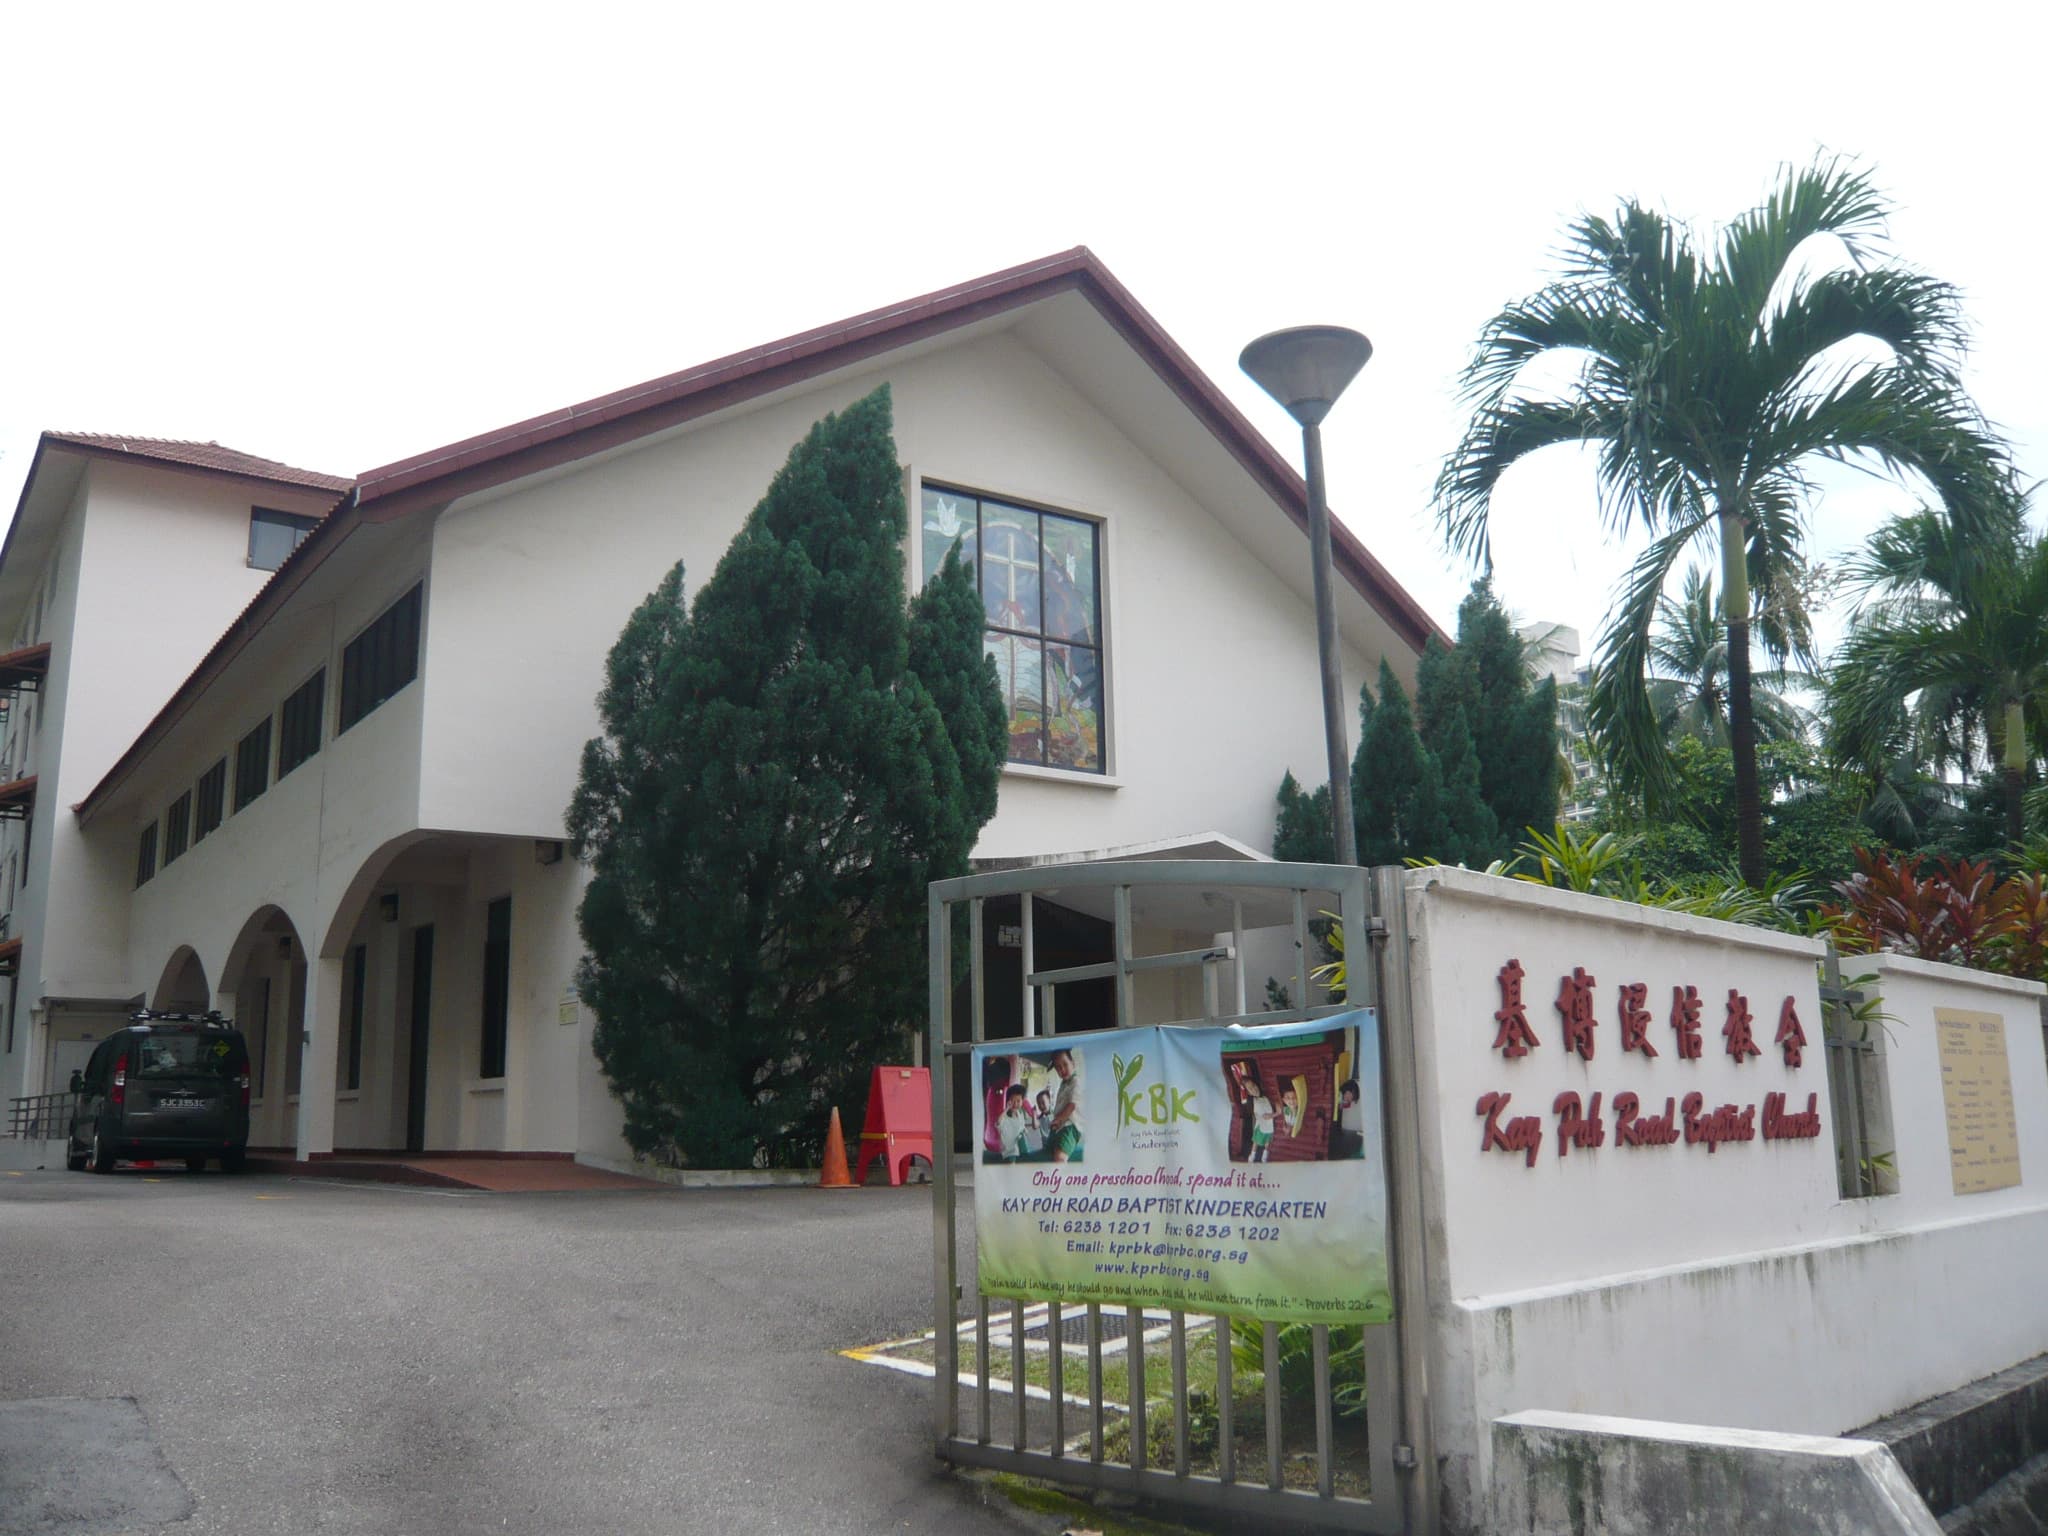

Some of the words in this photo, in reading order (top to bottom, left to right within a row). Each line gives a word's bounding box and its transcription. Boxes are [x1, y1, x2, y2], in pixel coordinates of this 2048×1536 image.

[1122, 1083, 1200, 1126] KBK
[1476, 1091, 1543, 1168] Kay
[1553, 1090, 1605, 1157] Poh
[1613, 1091, 1681, 1147] Road
[1681, 1091, 1757, 1154] Baptist
[1761, 1091, 1822, 1141] Church
[1032, 1168, 1061, 1193] Only
[1066, 1174, 1088, 1186] one
[1186, 1168, 1236, 1194] spend
[1237, 1172, 1247, 1188] it
[1002, 1197, 1031, 1213] KAY
[1032, 1197, 1063, 1213] POH
[1066, 1197, 1113, 1213] ROAD
[1117, 1197, 1182, 1215] BAPTIST
[1184, 1199, 1328, 1219] KINDERGARTEN
[1038, 1220, 1059, 1233] Tel:
[1063, 1220, 1102, 1234] 6238
[1107, 1221, 1151, 1234] 1201
[1185, 1224, 1231, 1239] 6238
[1239, 1226, 1280, 1241] 1202
[1066, 1240, 1104, 1253] Email:
[1115, 1284, 1131, 1297] and
[1134, 1285, 1159, 1297] when
[1255, 1293, 1278, 1310] from
[1305, 1297, 1346, 1311] Proverbs
